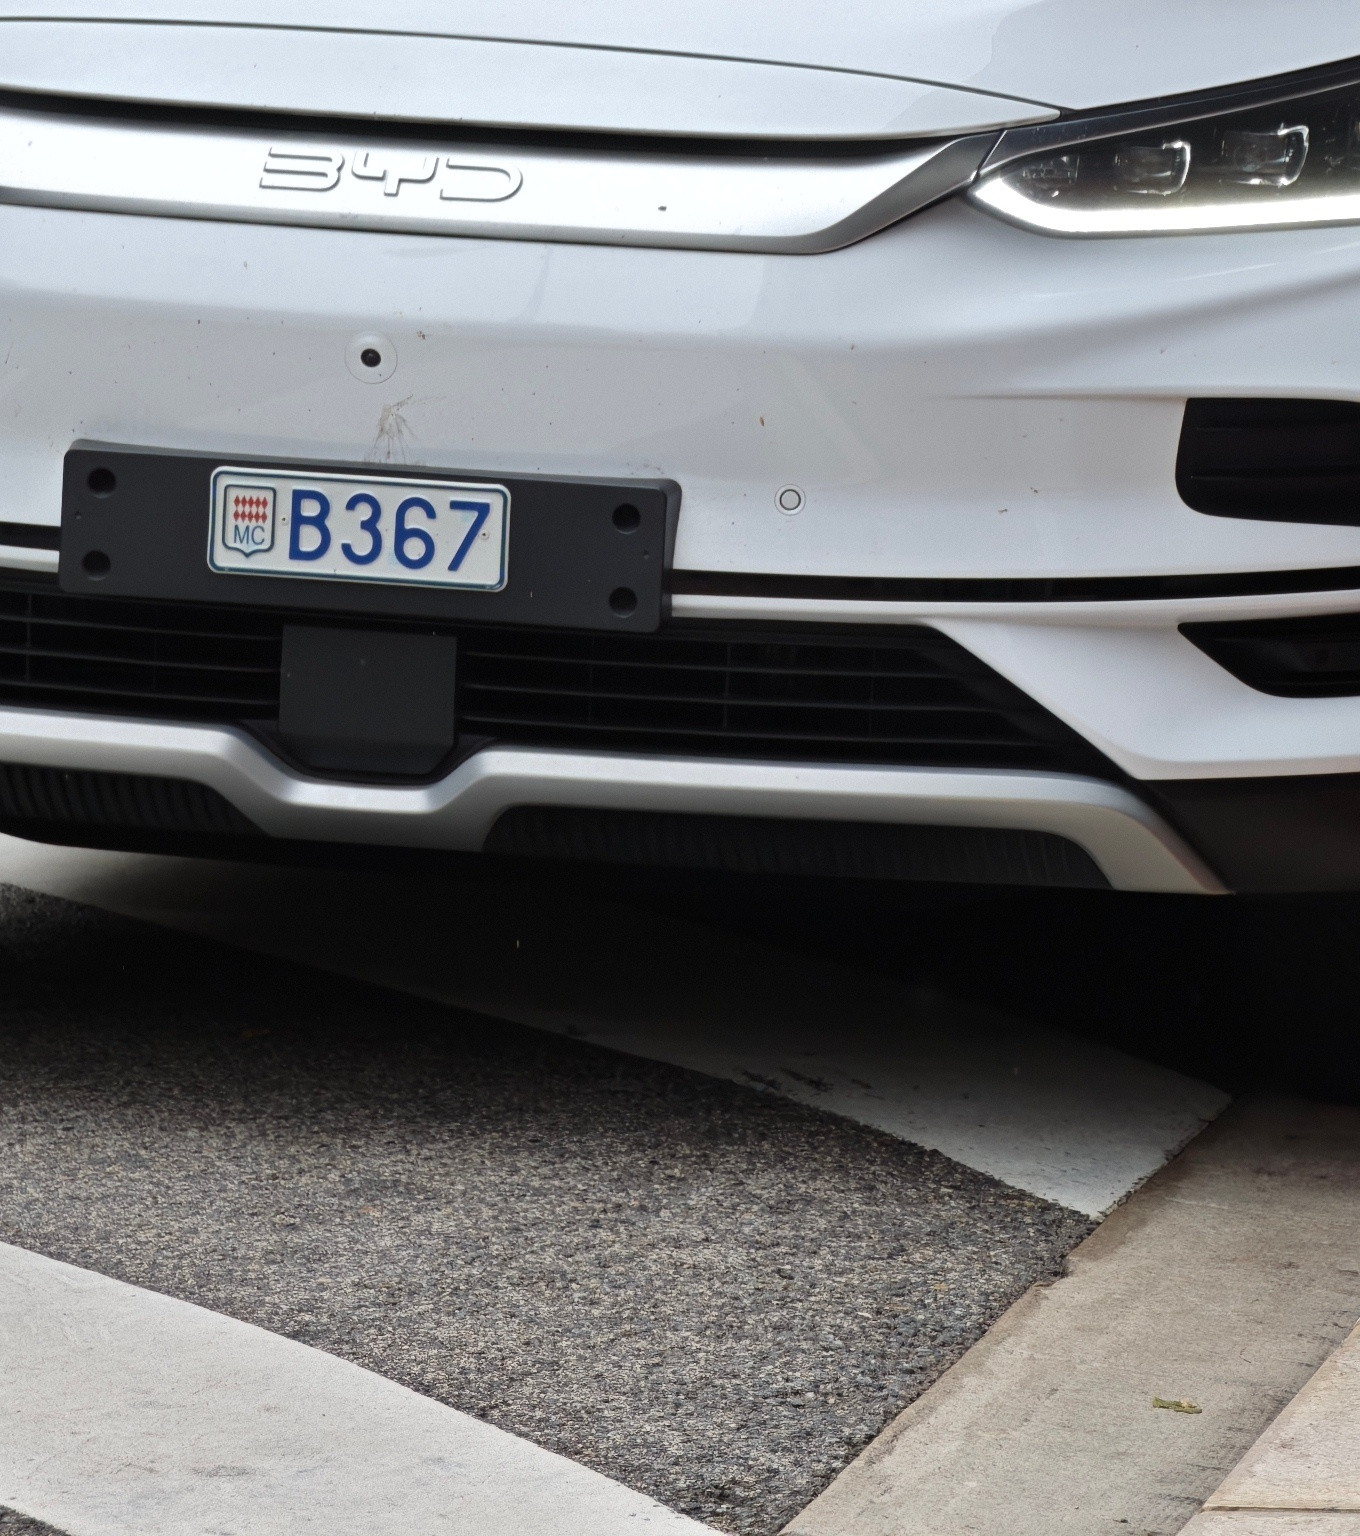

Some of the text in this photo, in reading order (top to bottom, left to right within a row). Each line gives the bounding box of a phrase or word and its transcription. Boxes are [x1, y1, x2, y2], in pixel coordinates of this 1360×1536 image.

[258, 146, 524, 203] BYD
[233, 524, 265, 546] MC
[289, 488, 491, 572] B367
